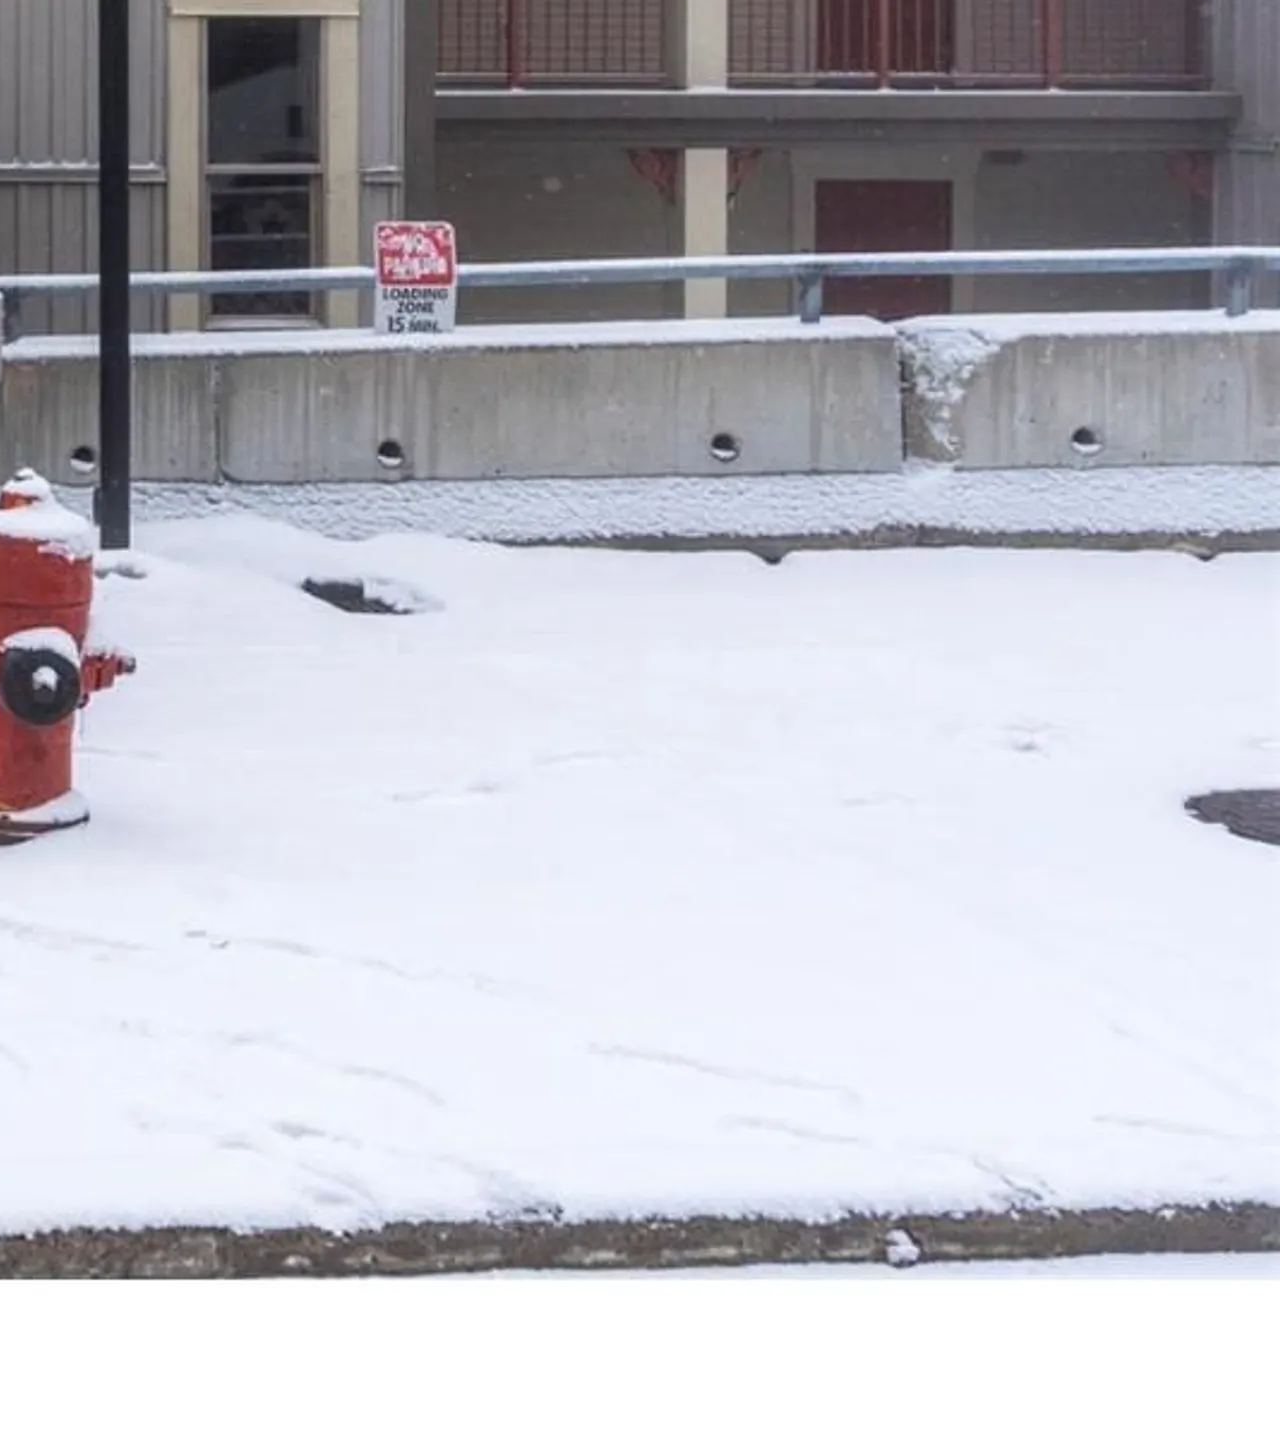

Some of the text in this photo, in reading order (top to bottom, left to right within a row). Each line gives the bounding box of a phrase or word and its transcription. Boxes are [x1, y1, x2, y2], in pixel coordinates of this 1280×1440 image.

[383, 287, 448, 301] LOADING
[397, 302, 434, 314] ZONE
[388, 315, 405, 333] 15
